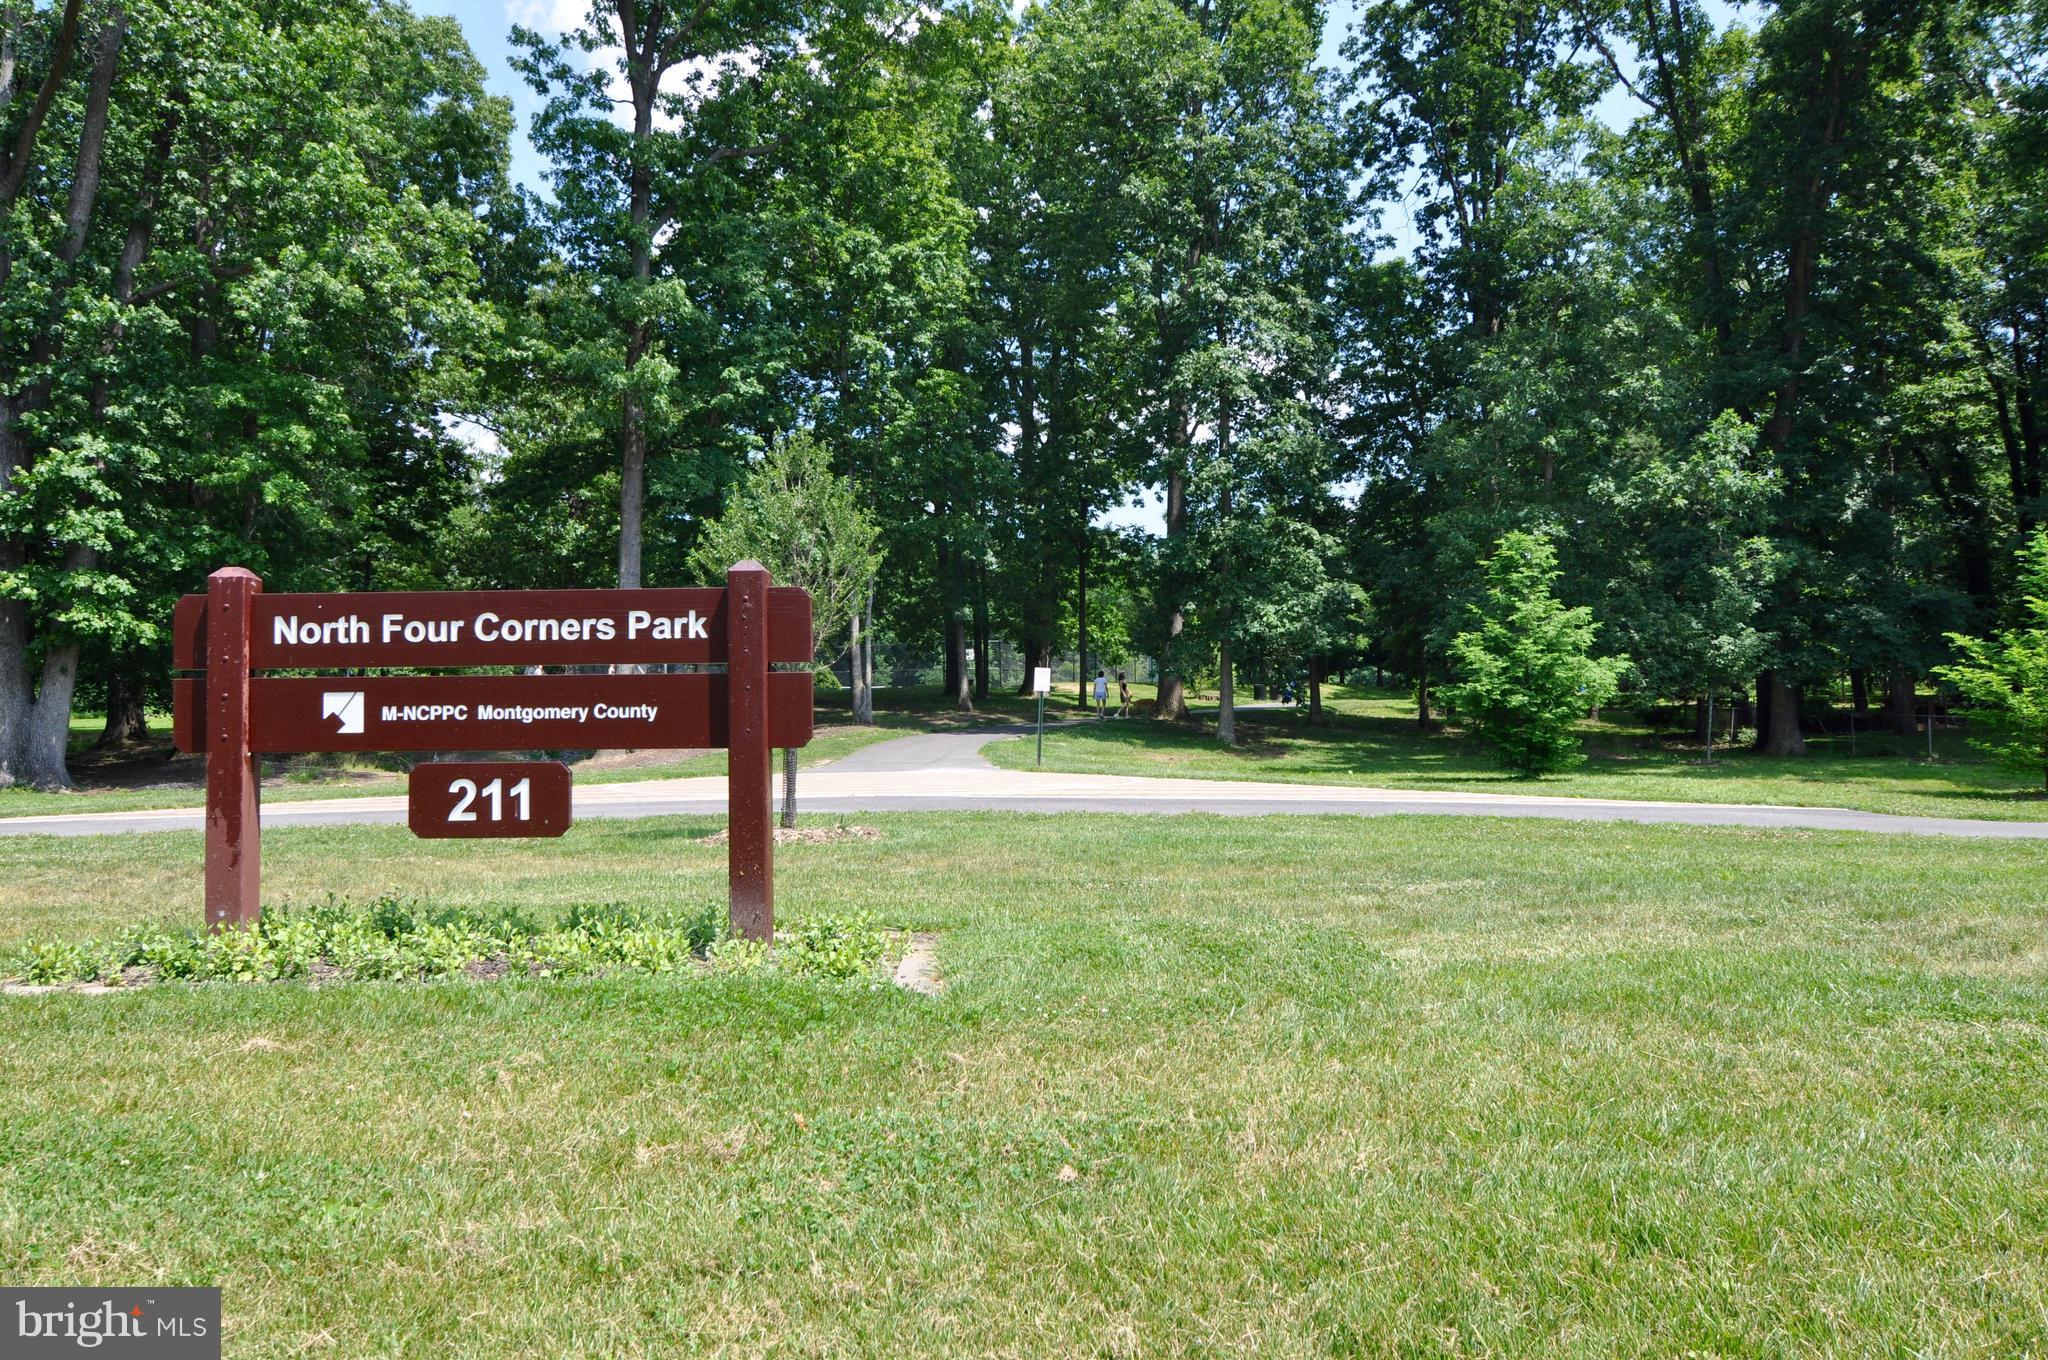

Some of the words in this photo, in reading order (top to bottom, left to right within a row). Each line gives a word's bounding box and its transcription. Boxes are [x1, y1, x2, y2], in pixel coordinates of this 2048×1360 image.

[273, 614, 370, 645] North
[382, 613, 465, 644] Four
[474, 611, 616, 642] Corners
[628, 609, 709, 640] Park
[381, 704, 468, 721] M-NCPPC
[477, 704, 589, 724] Montgomery
[593, 702, 658, 722] County
[447, 777, 531, 822] 211
